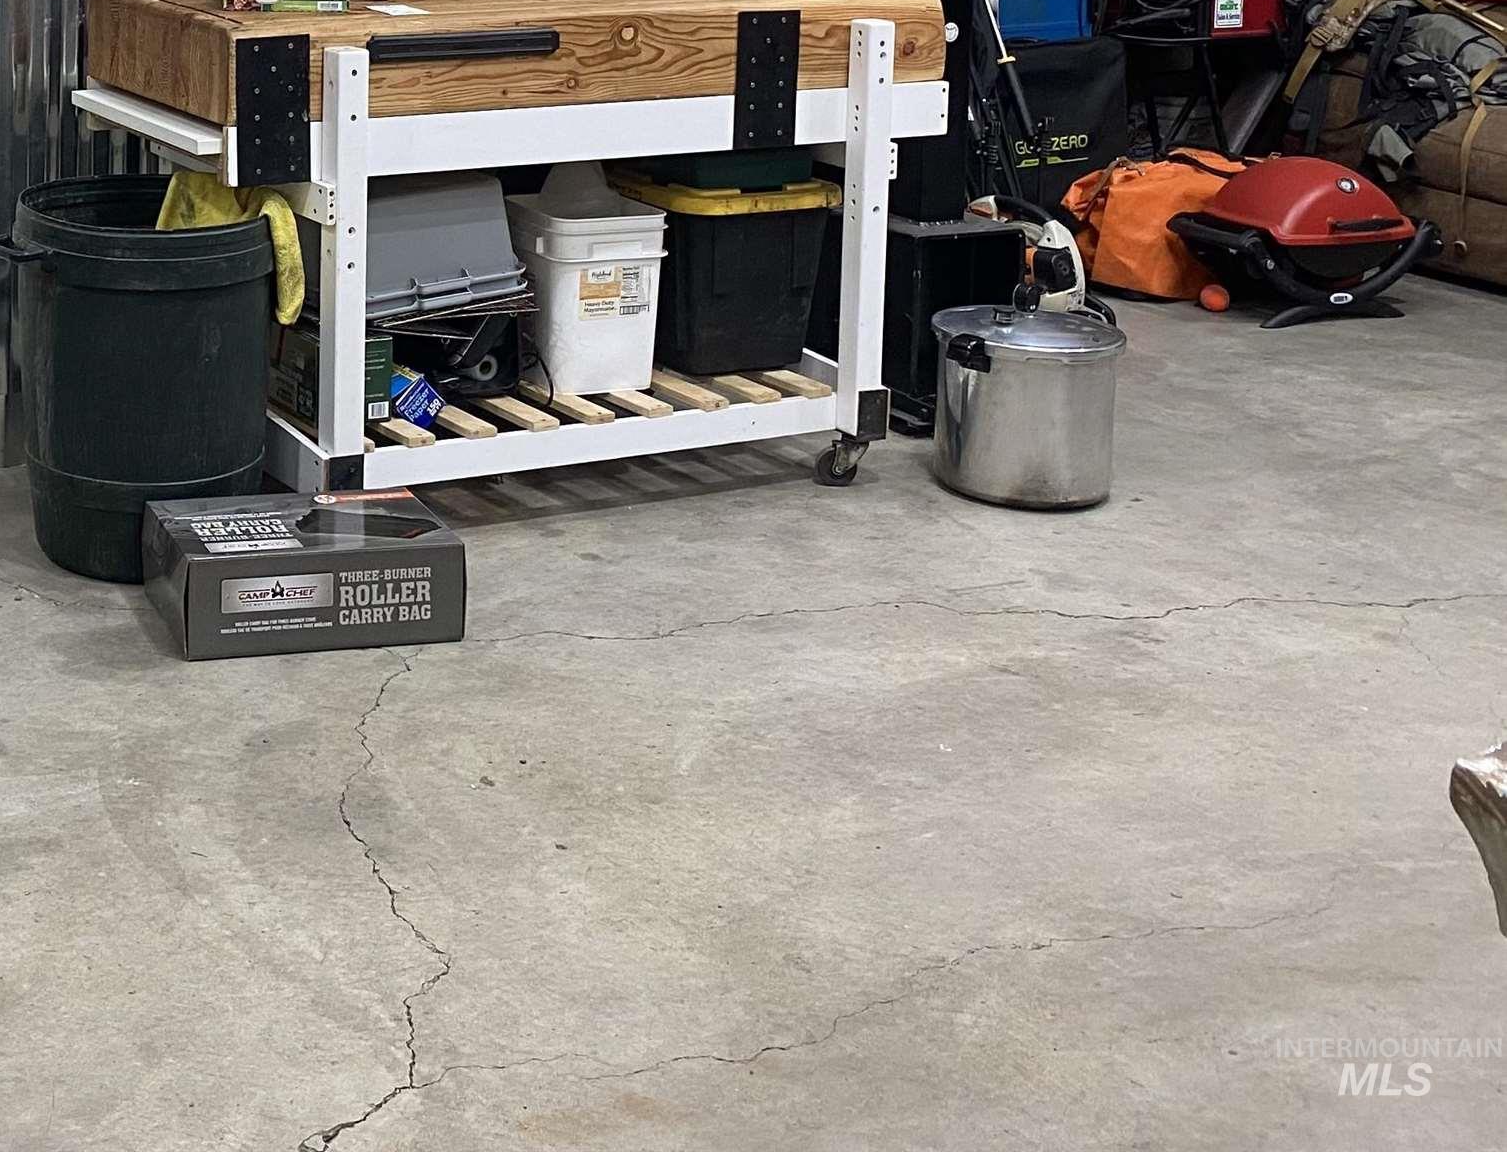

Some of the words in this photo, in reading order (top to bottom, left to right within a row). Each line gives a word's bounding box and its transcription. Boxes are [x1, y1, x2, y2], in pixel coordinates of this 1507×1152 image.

[1050, 134, 1088, 151] ZERO
[404, 388, 430, 418] Freezer
[426, 398, 440, 414] 150
[339, 567, 432, 584] THREE-BURNER
[238, 591, 271, 601] CAMP
[285, 588, 316, 598] CHEF
[339, 581, 432, 608] ROLLER
[339, 607, 395, 625] CARRY
[398, 605, 432, 622] BAG
